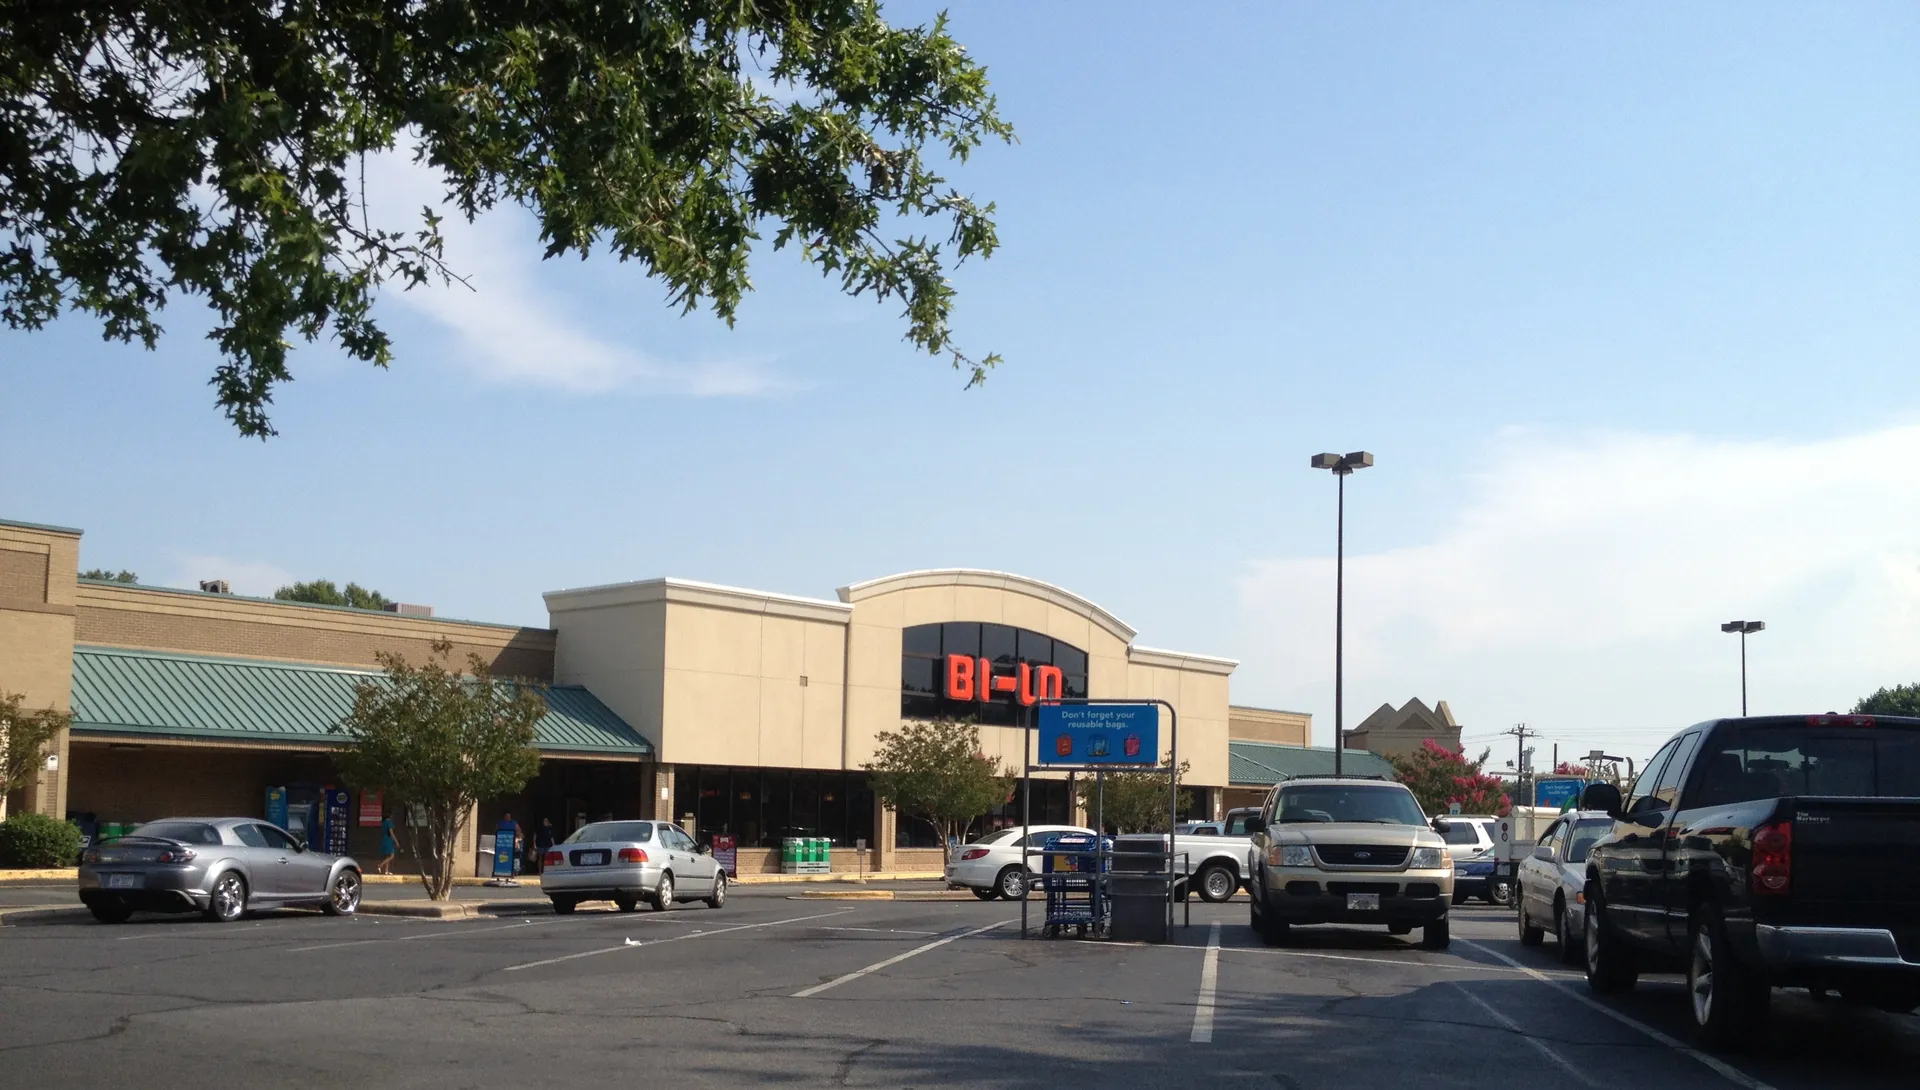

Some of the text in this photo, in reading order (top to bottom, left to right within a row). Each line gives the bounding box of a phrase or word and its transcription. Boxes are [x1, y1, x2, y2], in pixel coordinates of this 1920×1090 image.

[947, 653, 1063, 706] BI-LO
[1061, 710, 1136, 721] Don't forget your
[1068, 720, 1128, 729] reusable bags.
